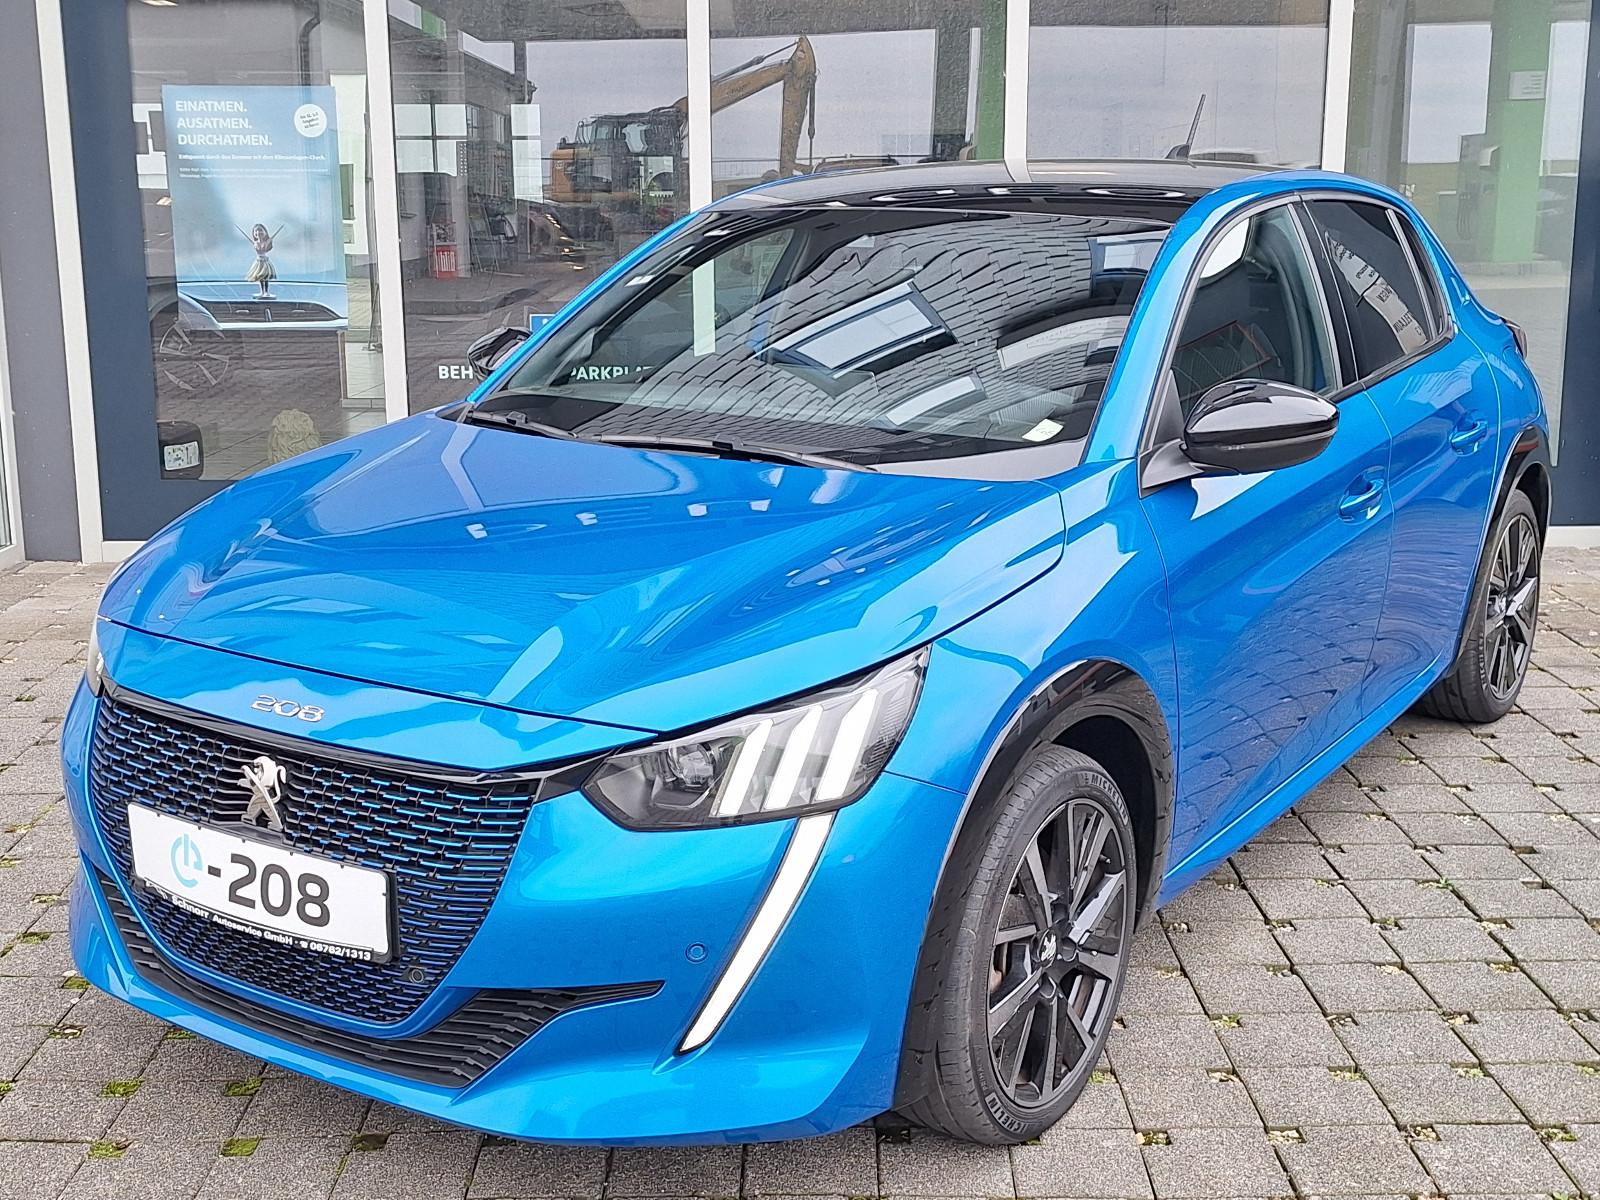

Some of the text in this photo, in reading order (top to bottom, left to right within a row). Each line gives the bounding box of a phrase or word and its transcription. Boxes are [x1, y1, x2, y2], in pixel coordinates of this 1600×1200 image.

[175, 100, 247, 112] EINATMEN.
[177, 117, 253, 129] AUSATMEN.
[178, 134, 273, 146] DURCHATMEN.
[251, 694, 326, 722] 208
[1091, 773, 1127, 820] MICHELIN
[171, 895, 210, 919] Schnorr
[212, 914, 262, 937] Autoservice
[263, 930, 293, 945] GmbH
